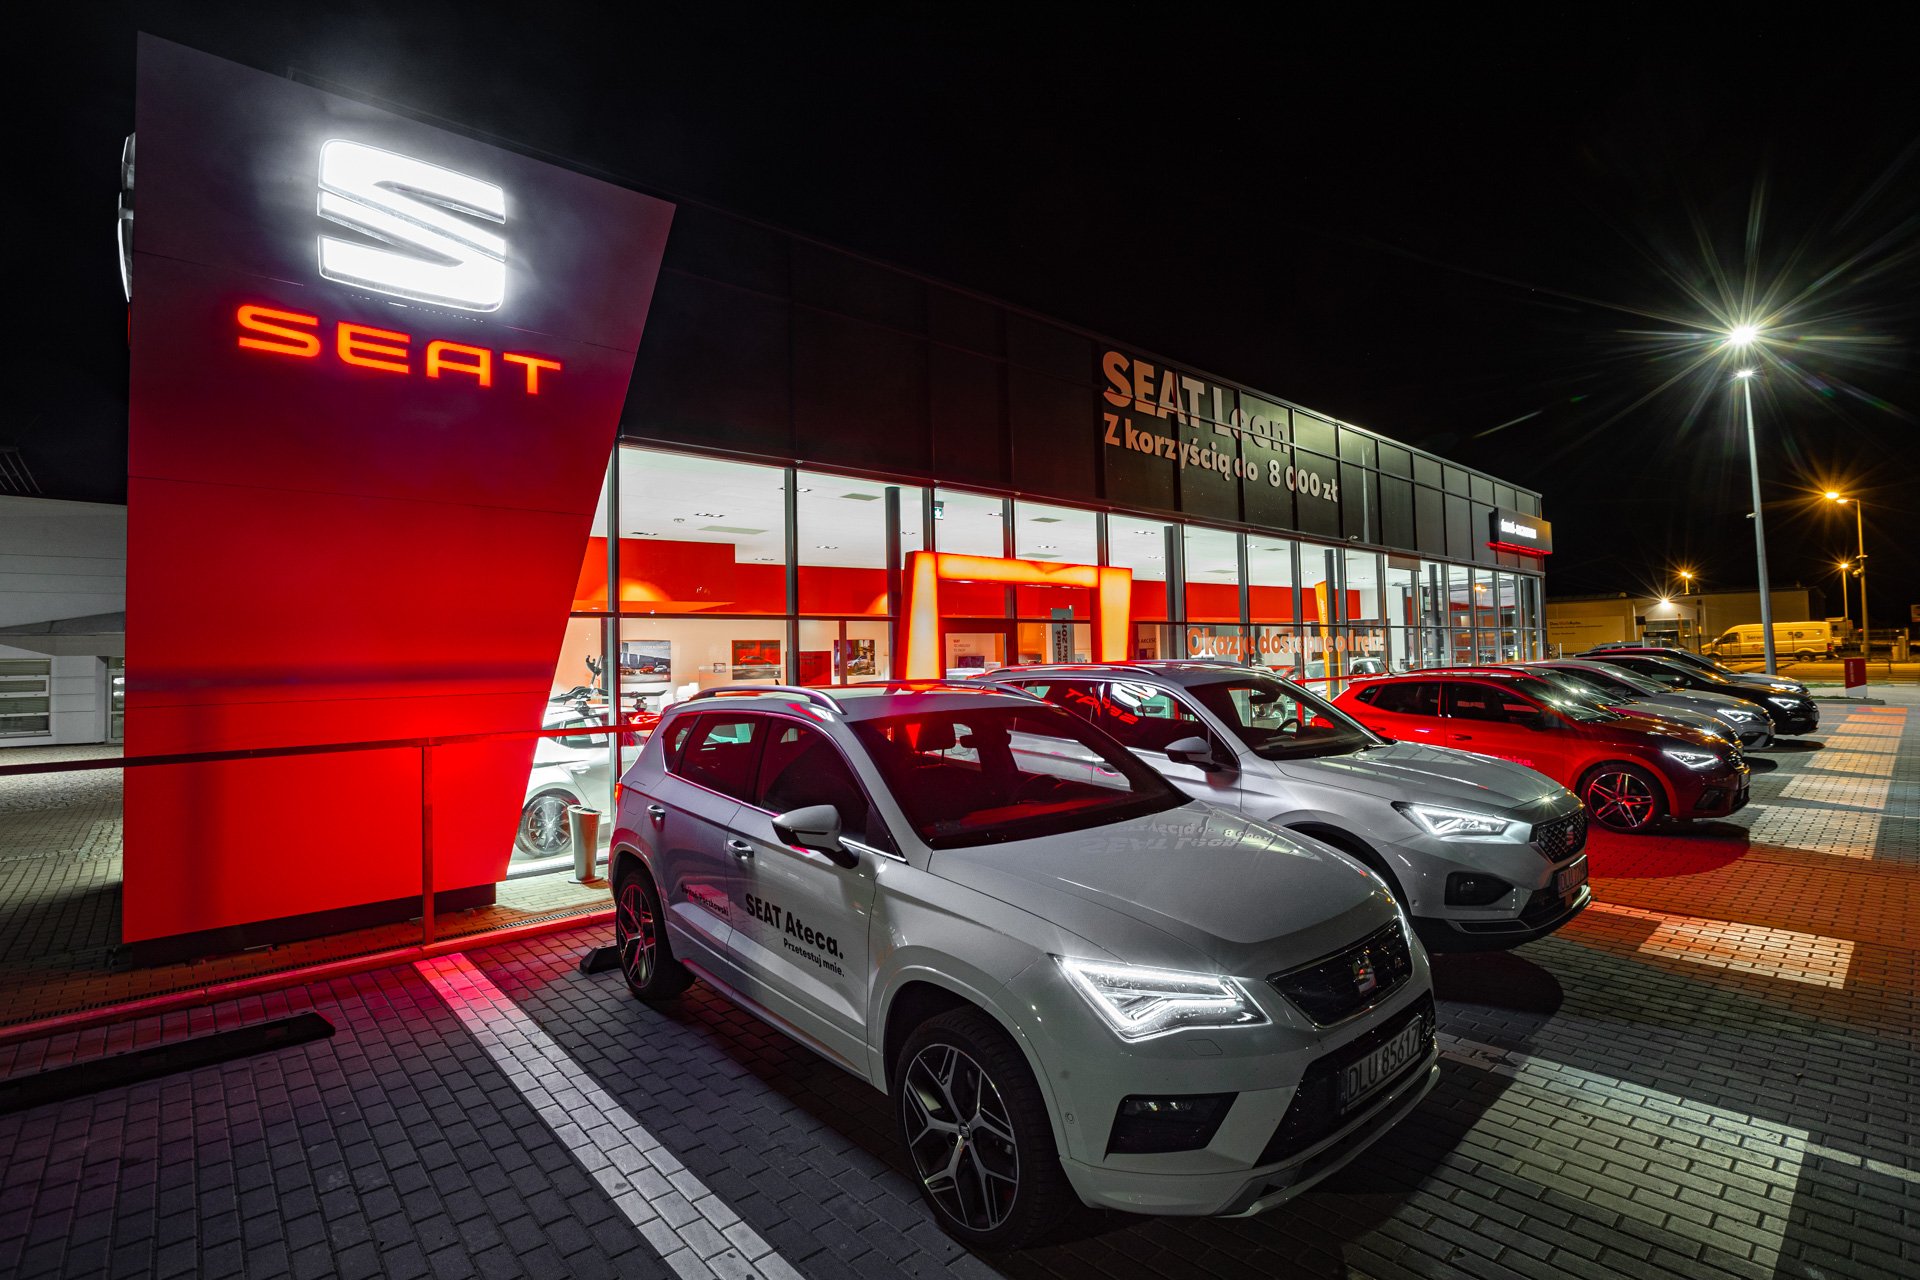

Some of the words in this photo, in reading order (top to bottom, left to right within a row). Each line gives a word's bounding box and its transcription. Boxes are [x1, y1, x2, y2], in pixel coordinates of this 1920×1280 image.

[237, 304, 561, 395] SEAT
[1102, 351, 1205, 428] SEAT
[1211, 386, 1291, 454] Leon
[1103, 412, 1120, 446] Z
[1124, 418, 1231, 482] korzyścią
[1233, 453, 1259, 482] do
[1322, 478, 1338, 503] zł
[1187, 626, 1256, 663] Okazje
[1335, 629, 1355, 653] od
[745, 892, 782, 930] SEAT
[784, 911, 845, 960] Ateca.
[783, 937, 822, 968] Przetestuj
[822, 960, 845, 978] mnie.
[1349, 1056, 1378, 1099] DLU
[1382, 1025, 1420, 1077] 85617
